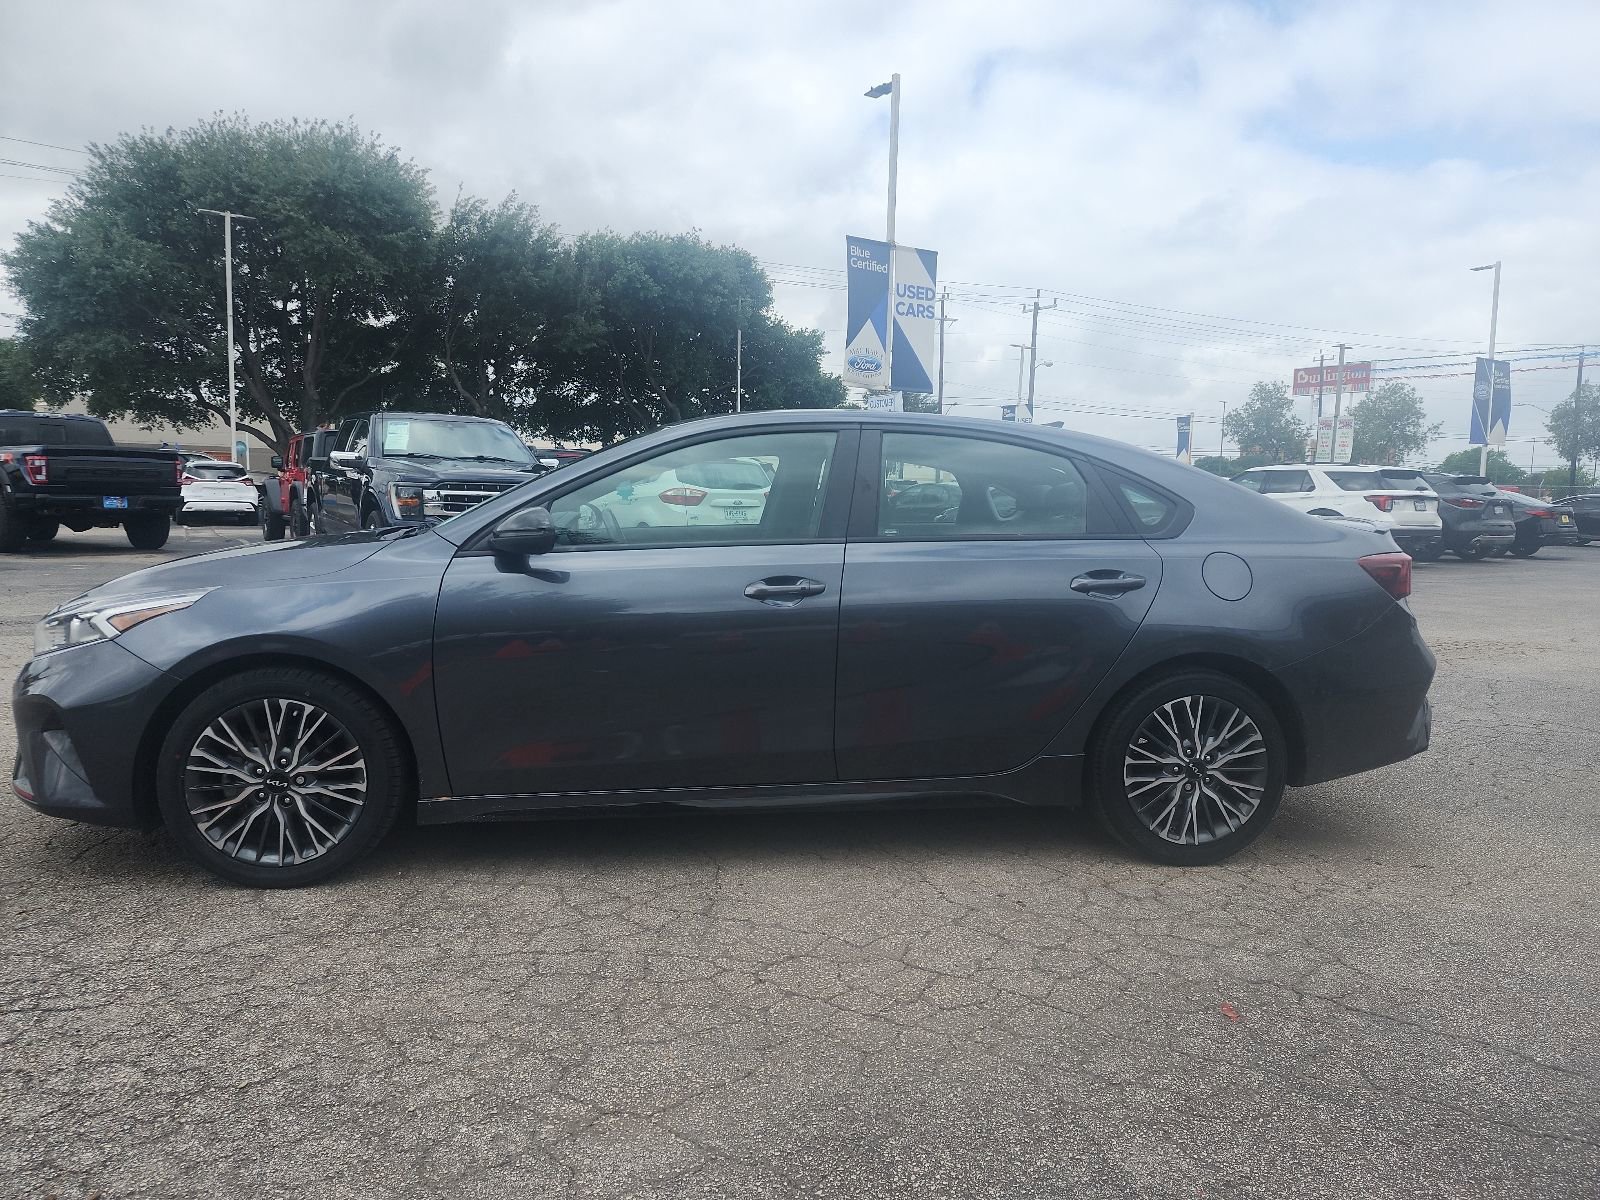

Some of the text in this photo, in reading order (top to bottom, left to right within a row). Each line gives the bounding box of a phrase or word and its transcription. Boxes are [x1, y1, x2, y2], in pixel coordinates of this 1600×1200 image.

[850, 245, 871, 259] Blue
[850, 257, 888, 274] Certified
[896, 282, 936, 302] USED
[895, 301, 935, 320] CARS
[854, 357, 877, 370] Ford
